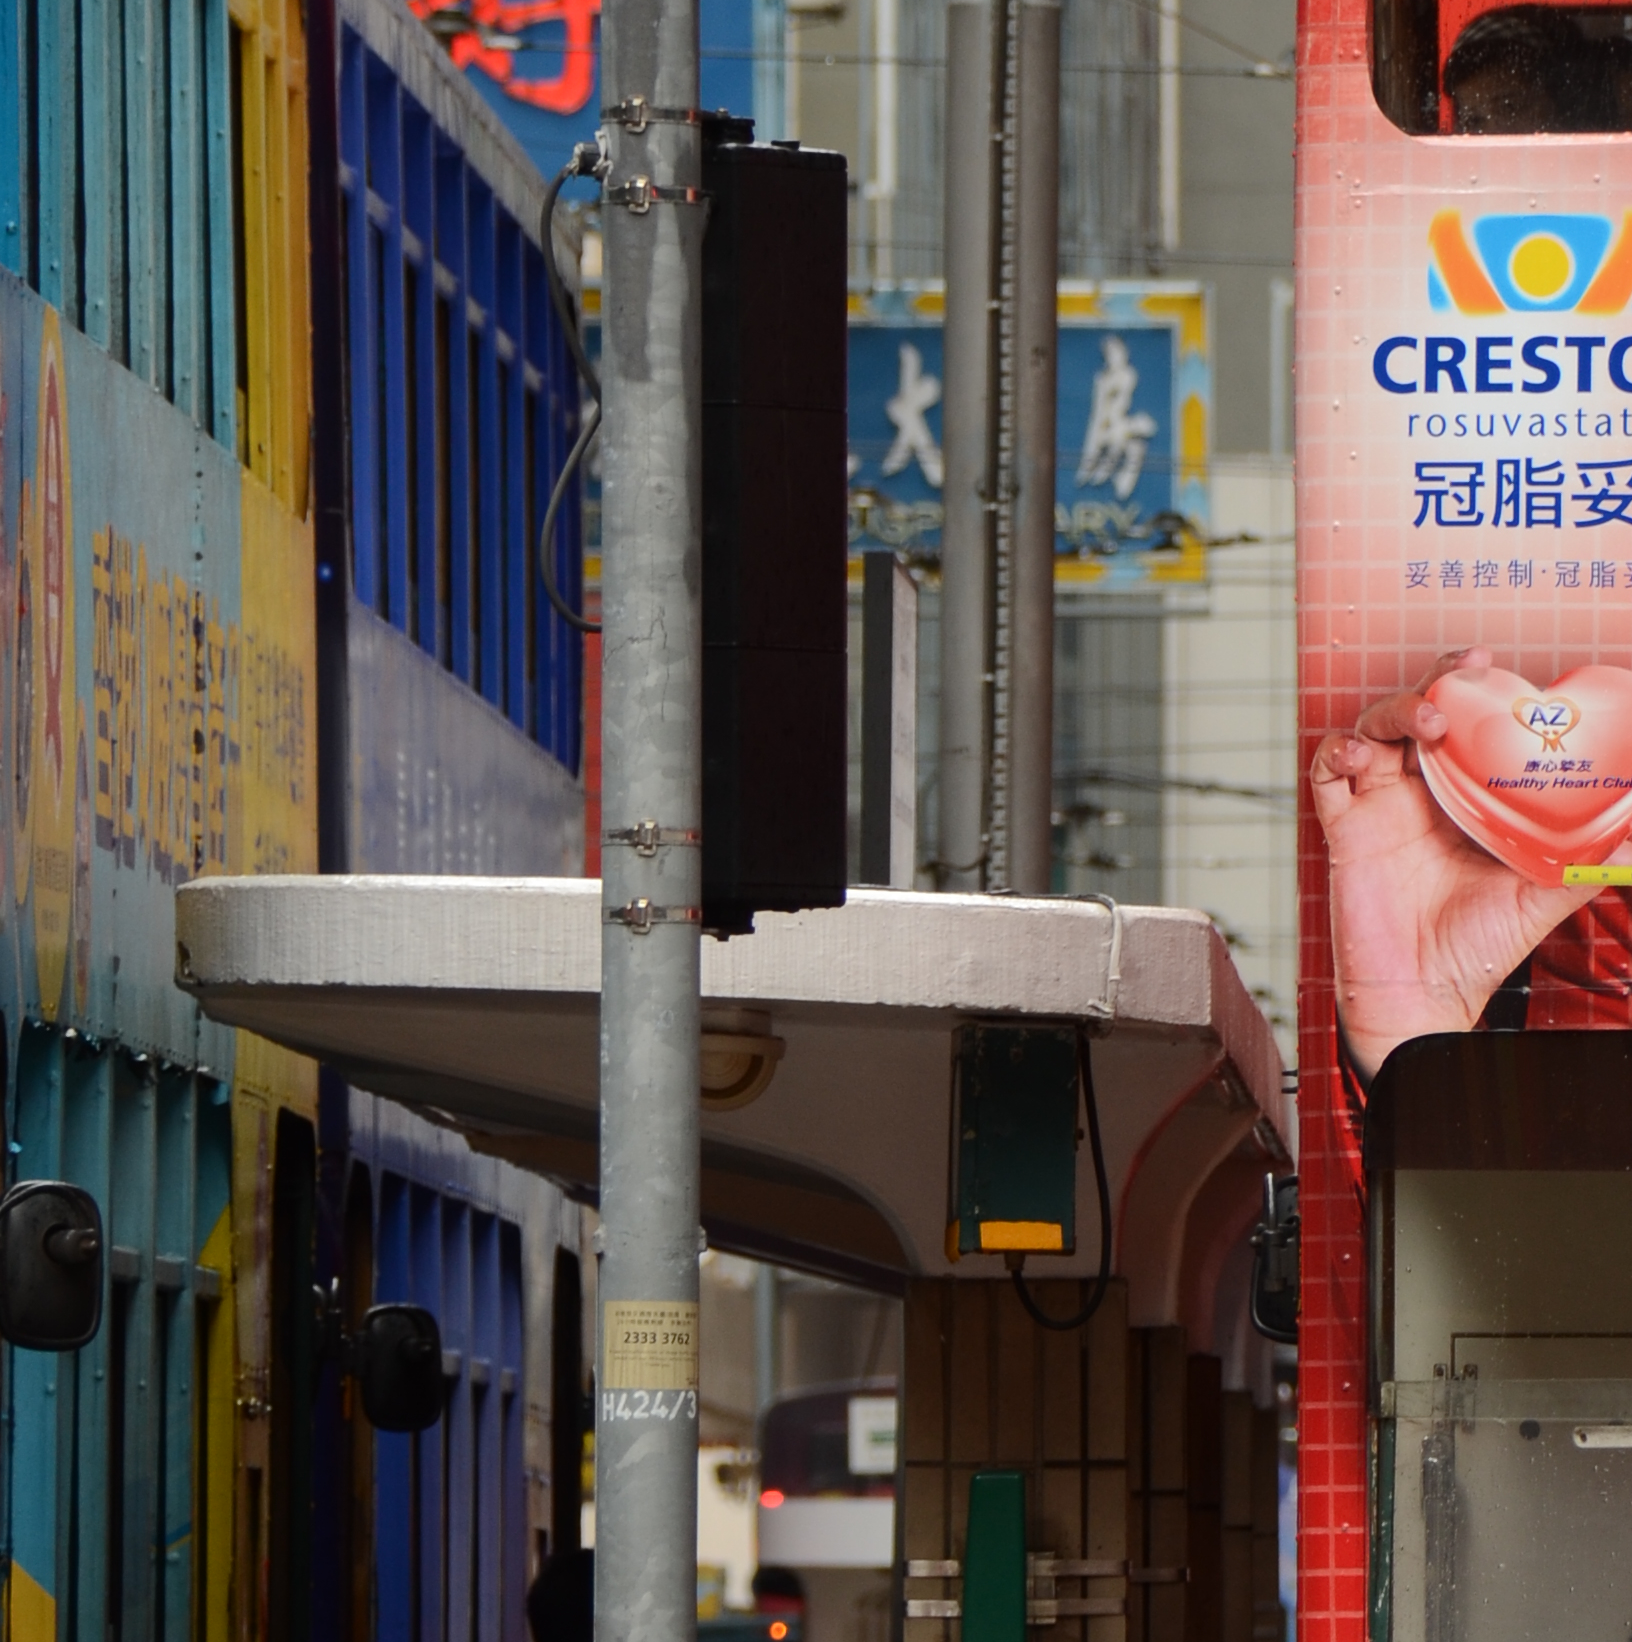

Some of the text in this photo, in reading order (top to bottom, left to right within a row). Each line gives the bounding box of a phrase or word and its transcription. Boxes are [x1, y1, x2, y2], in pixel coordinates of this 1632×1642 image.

[1528, 705, 1568, 727] AZ
[1486, 776, 1549, 793] Healthy
[1551, 776, 1600, 789] Heart
[623, 1331, 691, 1346] 2333 3762
[602, 1390, 698, 1422] H424/3
